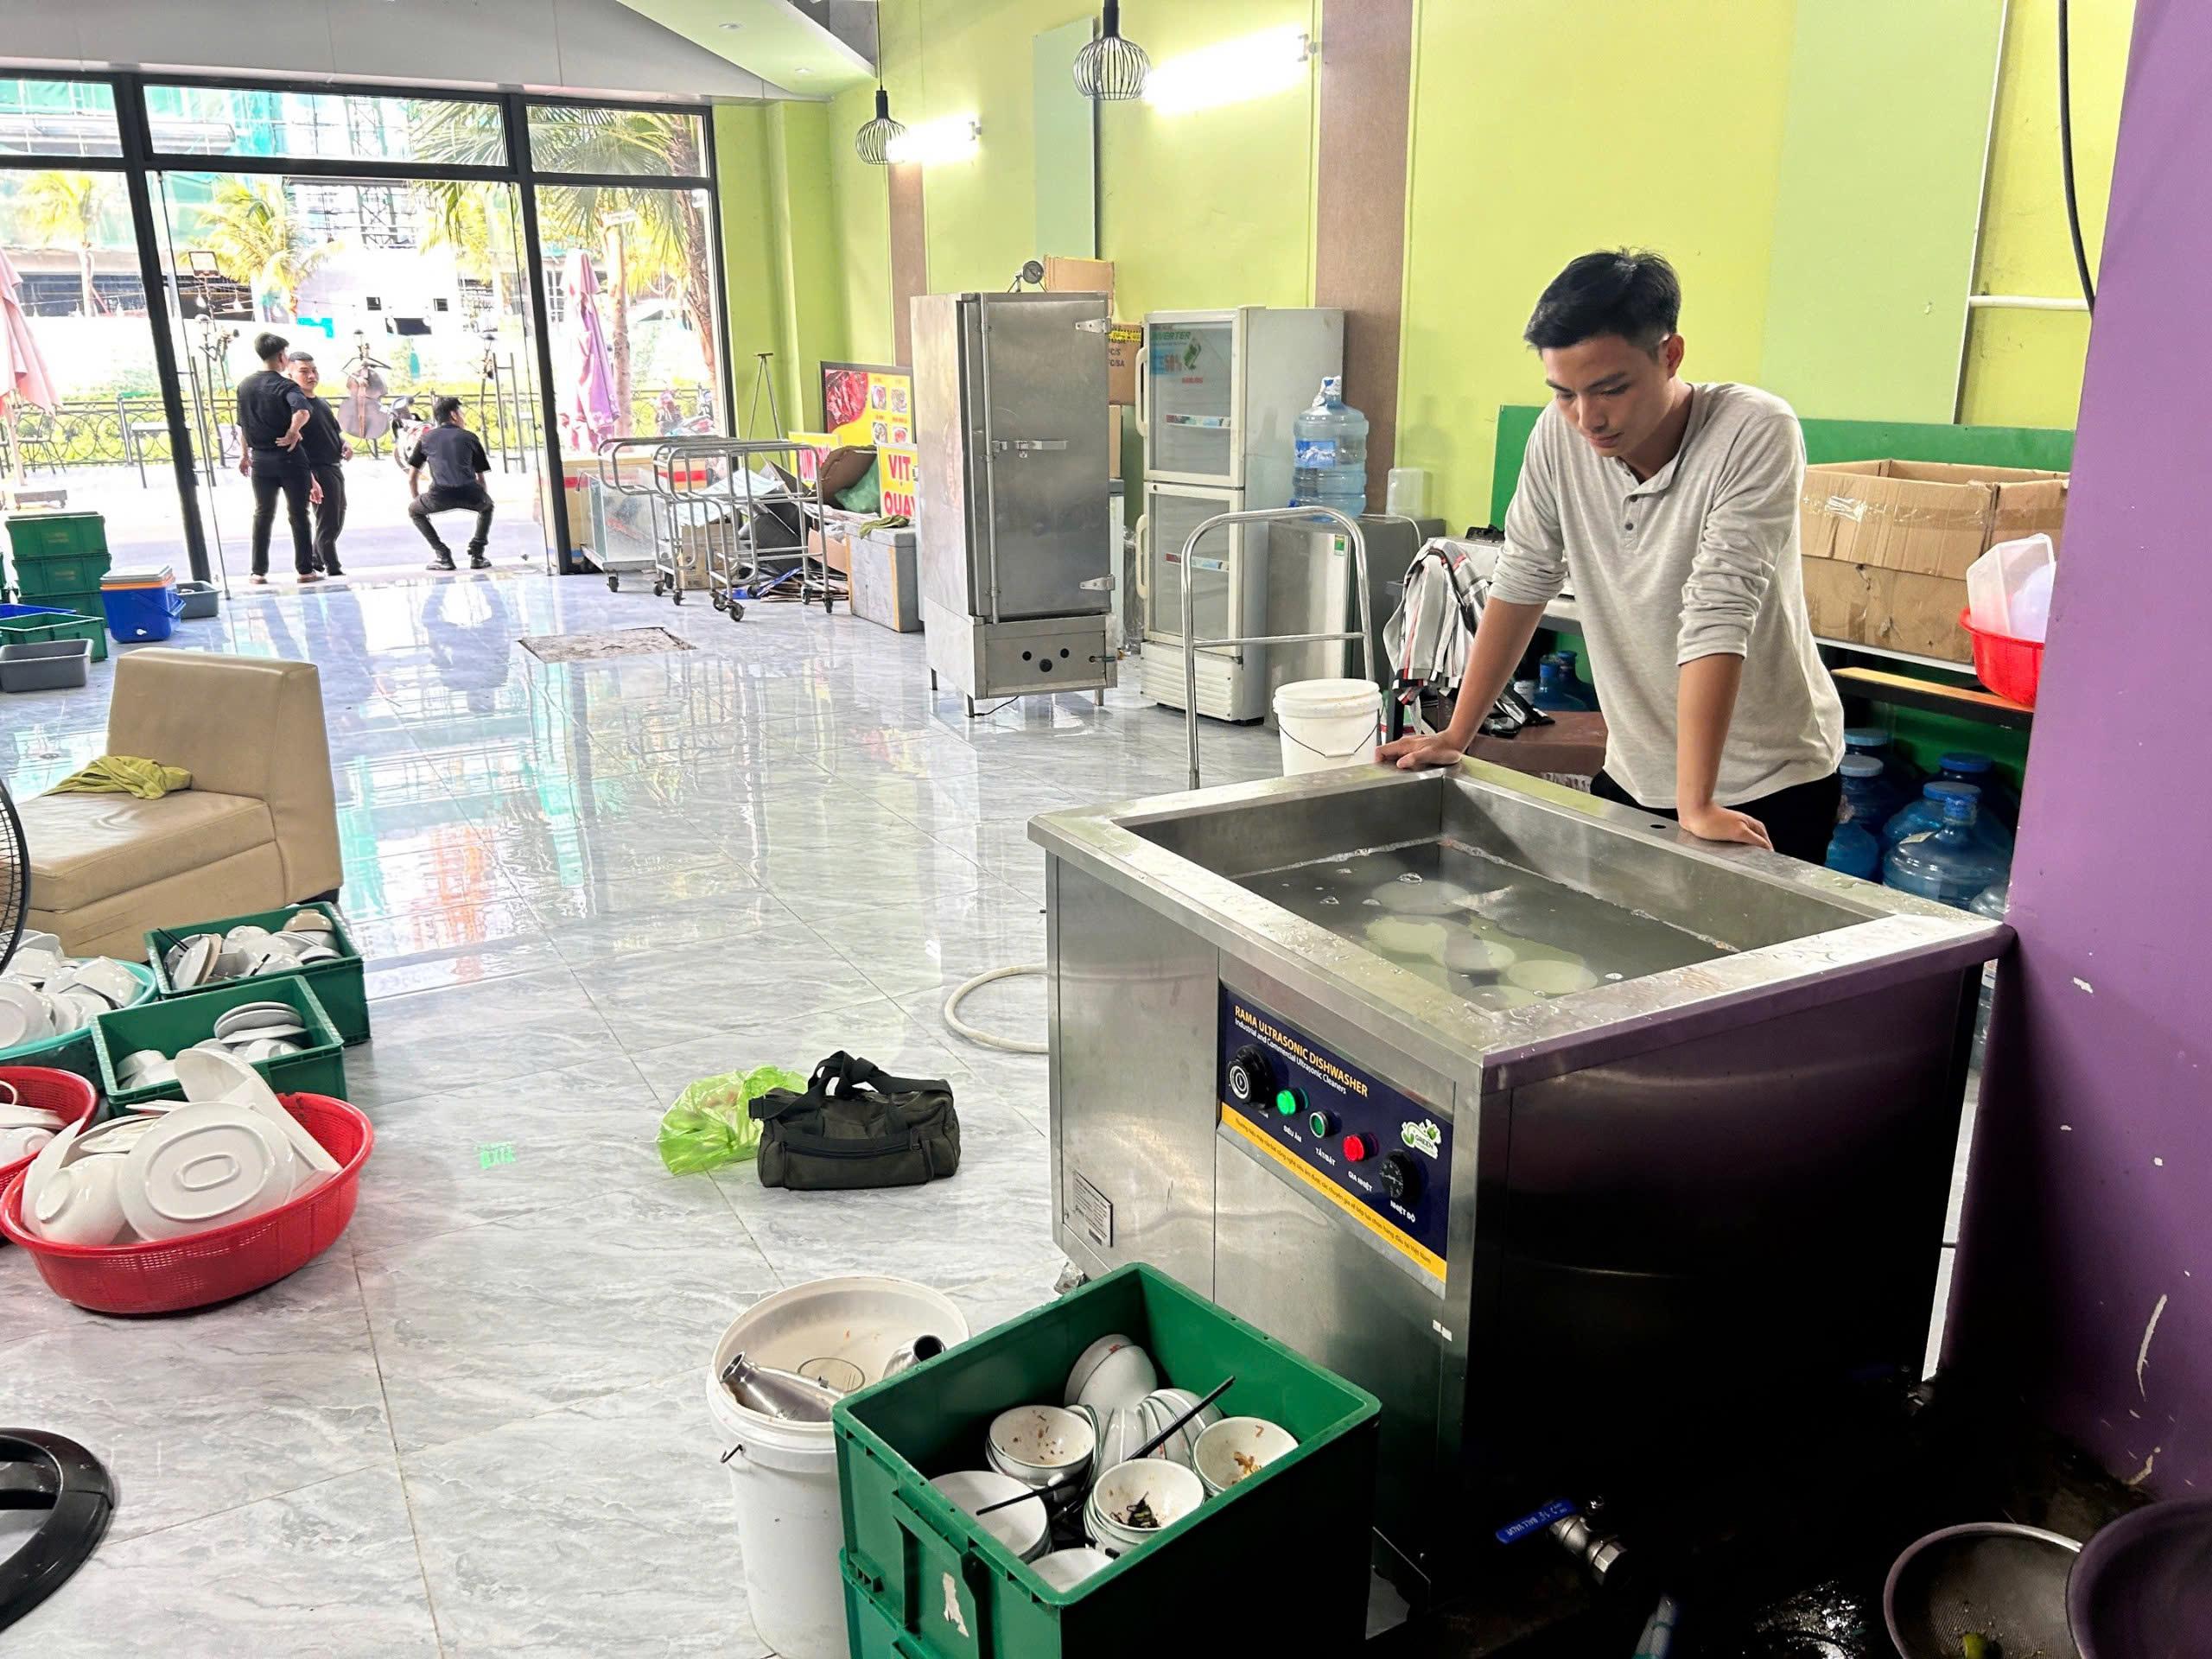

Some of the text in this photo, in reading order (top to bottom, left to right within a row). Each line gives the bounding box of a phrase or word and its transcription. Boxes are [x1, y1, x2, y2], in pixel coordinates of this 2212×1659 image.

[888, 454, 911, 486] VỊT
[1235, 1005, 1369, 1097] RAMA ULTRASONIC DISHWASHER
[1235, 1018, 1347, 1095] Industrial and Commercial Ultrasonic Cleaners
